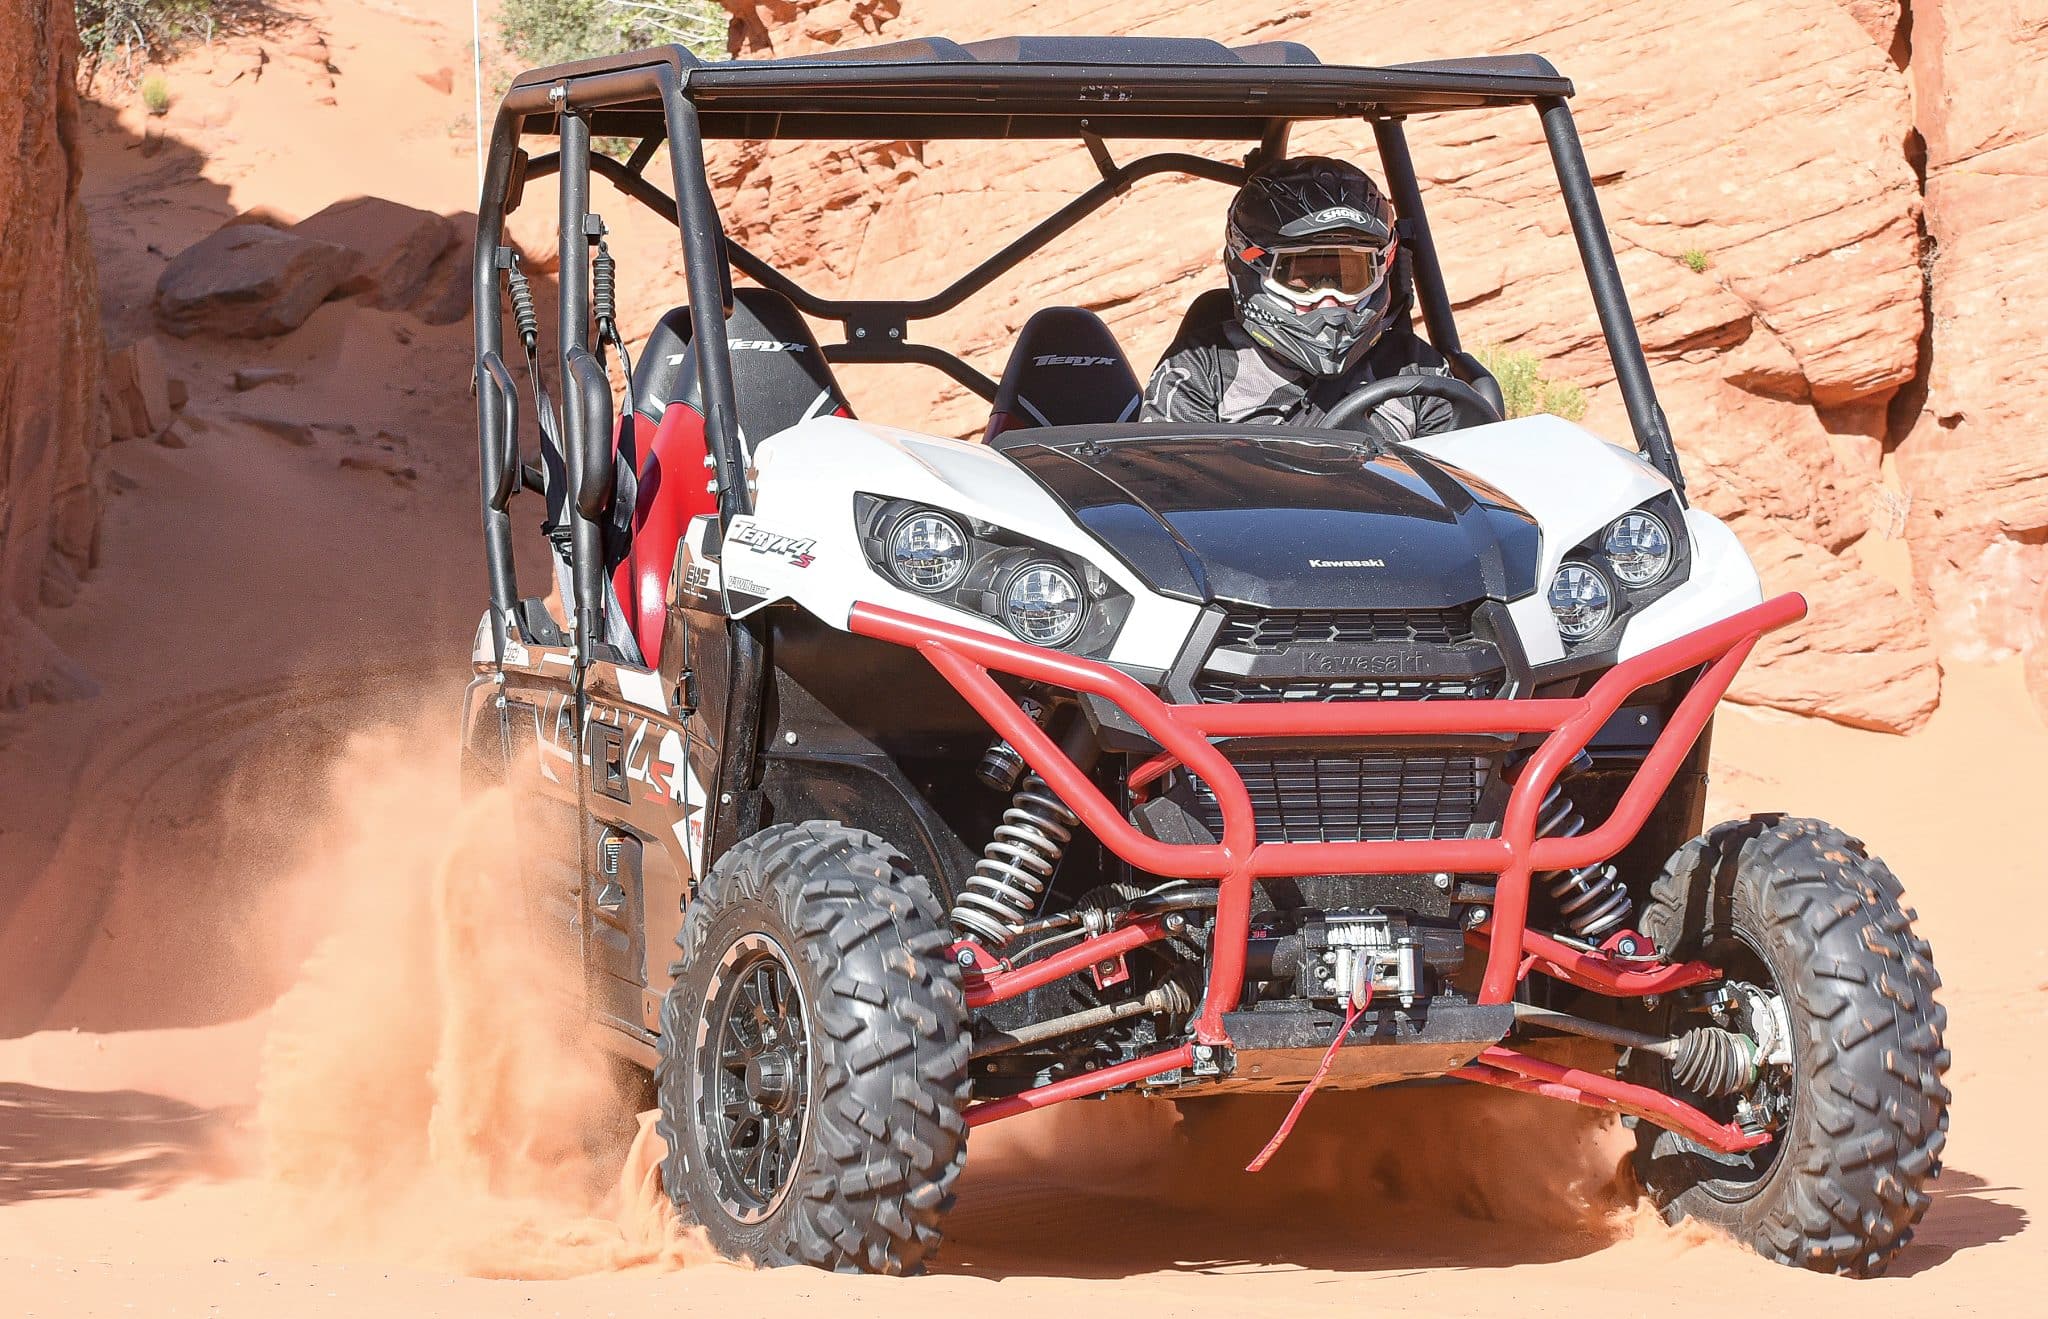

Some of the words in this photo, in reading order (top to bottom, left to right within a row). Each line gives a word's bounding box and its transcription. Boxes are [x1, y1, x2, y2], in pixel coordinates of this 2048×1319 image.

[1032, 354, 1118, 367] TERYX
[1308, 559, 1386, 568] Kawasaki
[1301, 649, 1424, 673] Kawasaki
